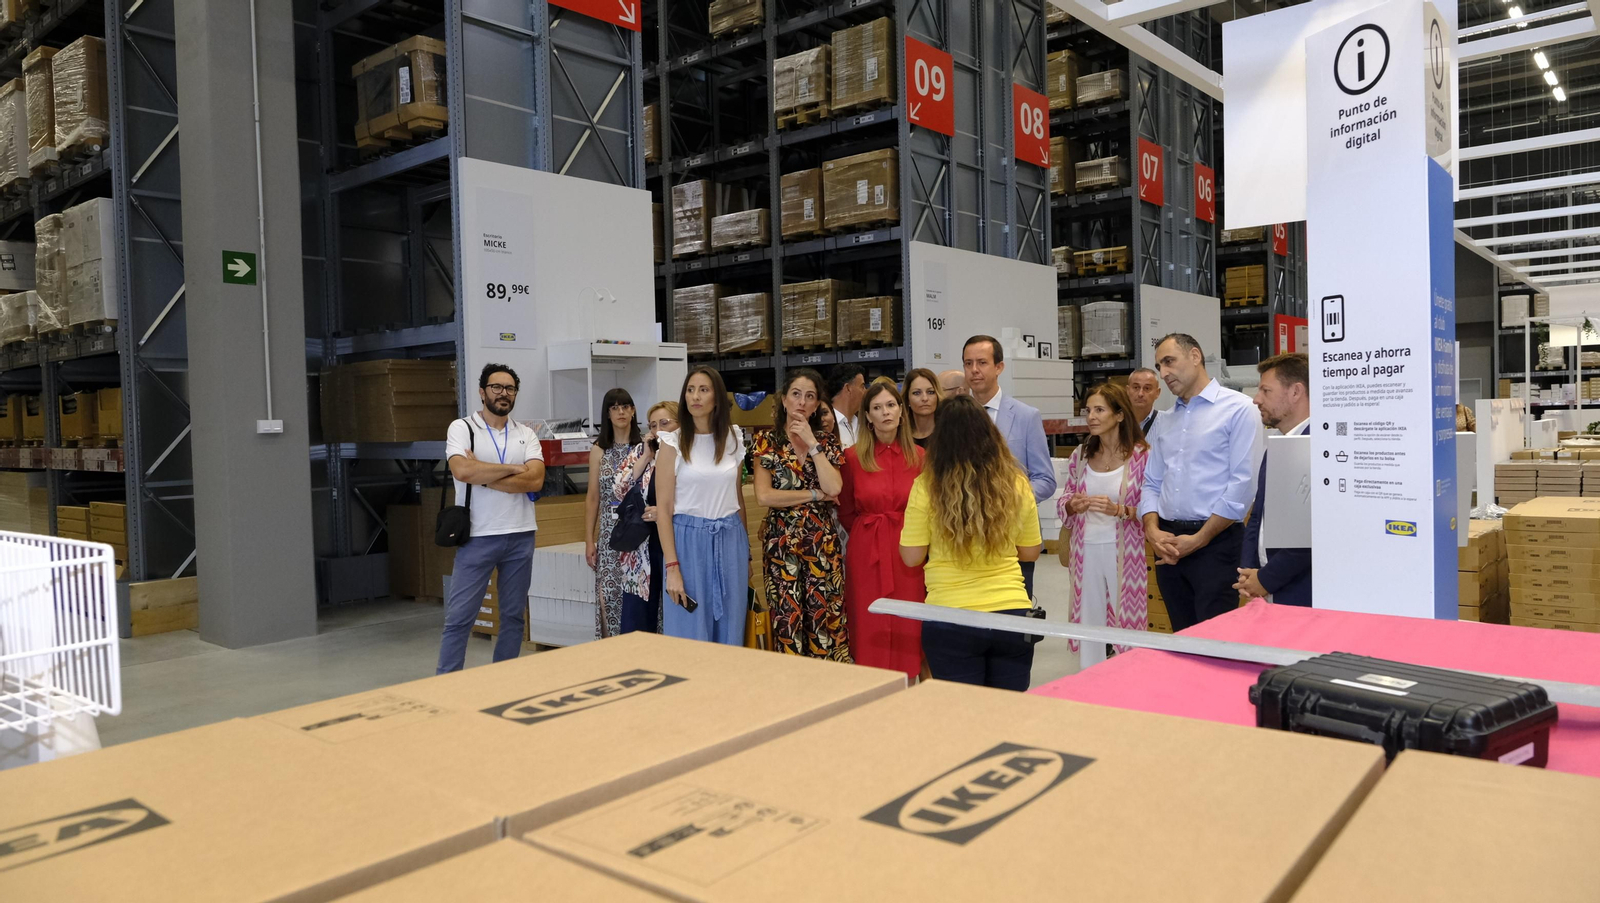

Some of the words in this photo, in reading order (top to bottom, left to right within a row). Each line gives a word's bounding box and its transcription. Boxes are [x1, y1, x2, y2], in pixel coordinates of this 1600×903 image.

[914, 58, 946, 102] 09
[1338, 102, 1370, 120] Punto
[1373, 96, 1387, 108] de
[1020, 102, 1044, 140] 08
[1330, 109, 1397, 138] información
[1345, 128, 1380, 149] digital
[1142, 152, 1158, 182] 07
[1198, 175, 1212, 203] 06
[1274, 223, 1285, 239] 05
[484, 240, 506, 249] MICKE
[486, 283, 530, 302] 89,99€
[927, 318, 946, 330] 169€
[1322, 351, 1362, 362] Escanea
[1366, 351, 1372, 362] y
[1374, 347, 1411, 358] ahorra
[1322, 367, 1358, 379] tiempo
[1361, 364, 1370, 375] al
[1373, 364, 1405, 378] pagar
[1389, 524, 1414, 532] IKEA
[513, 673, 660, 715] IKEA
[908, 755, 1057, 827] IKEA
